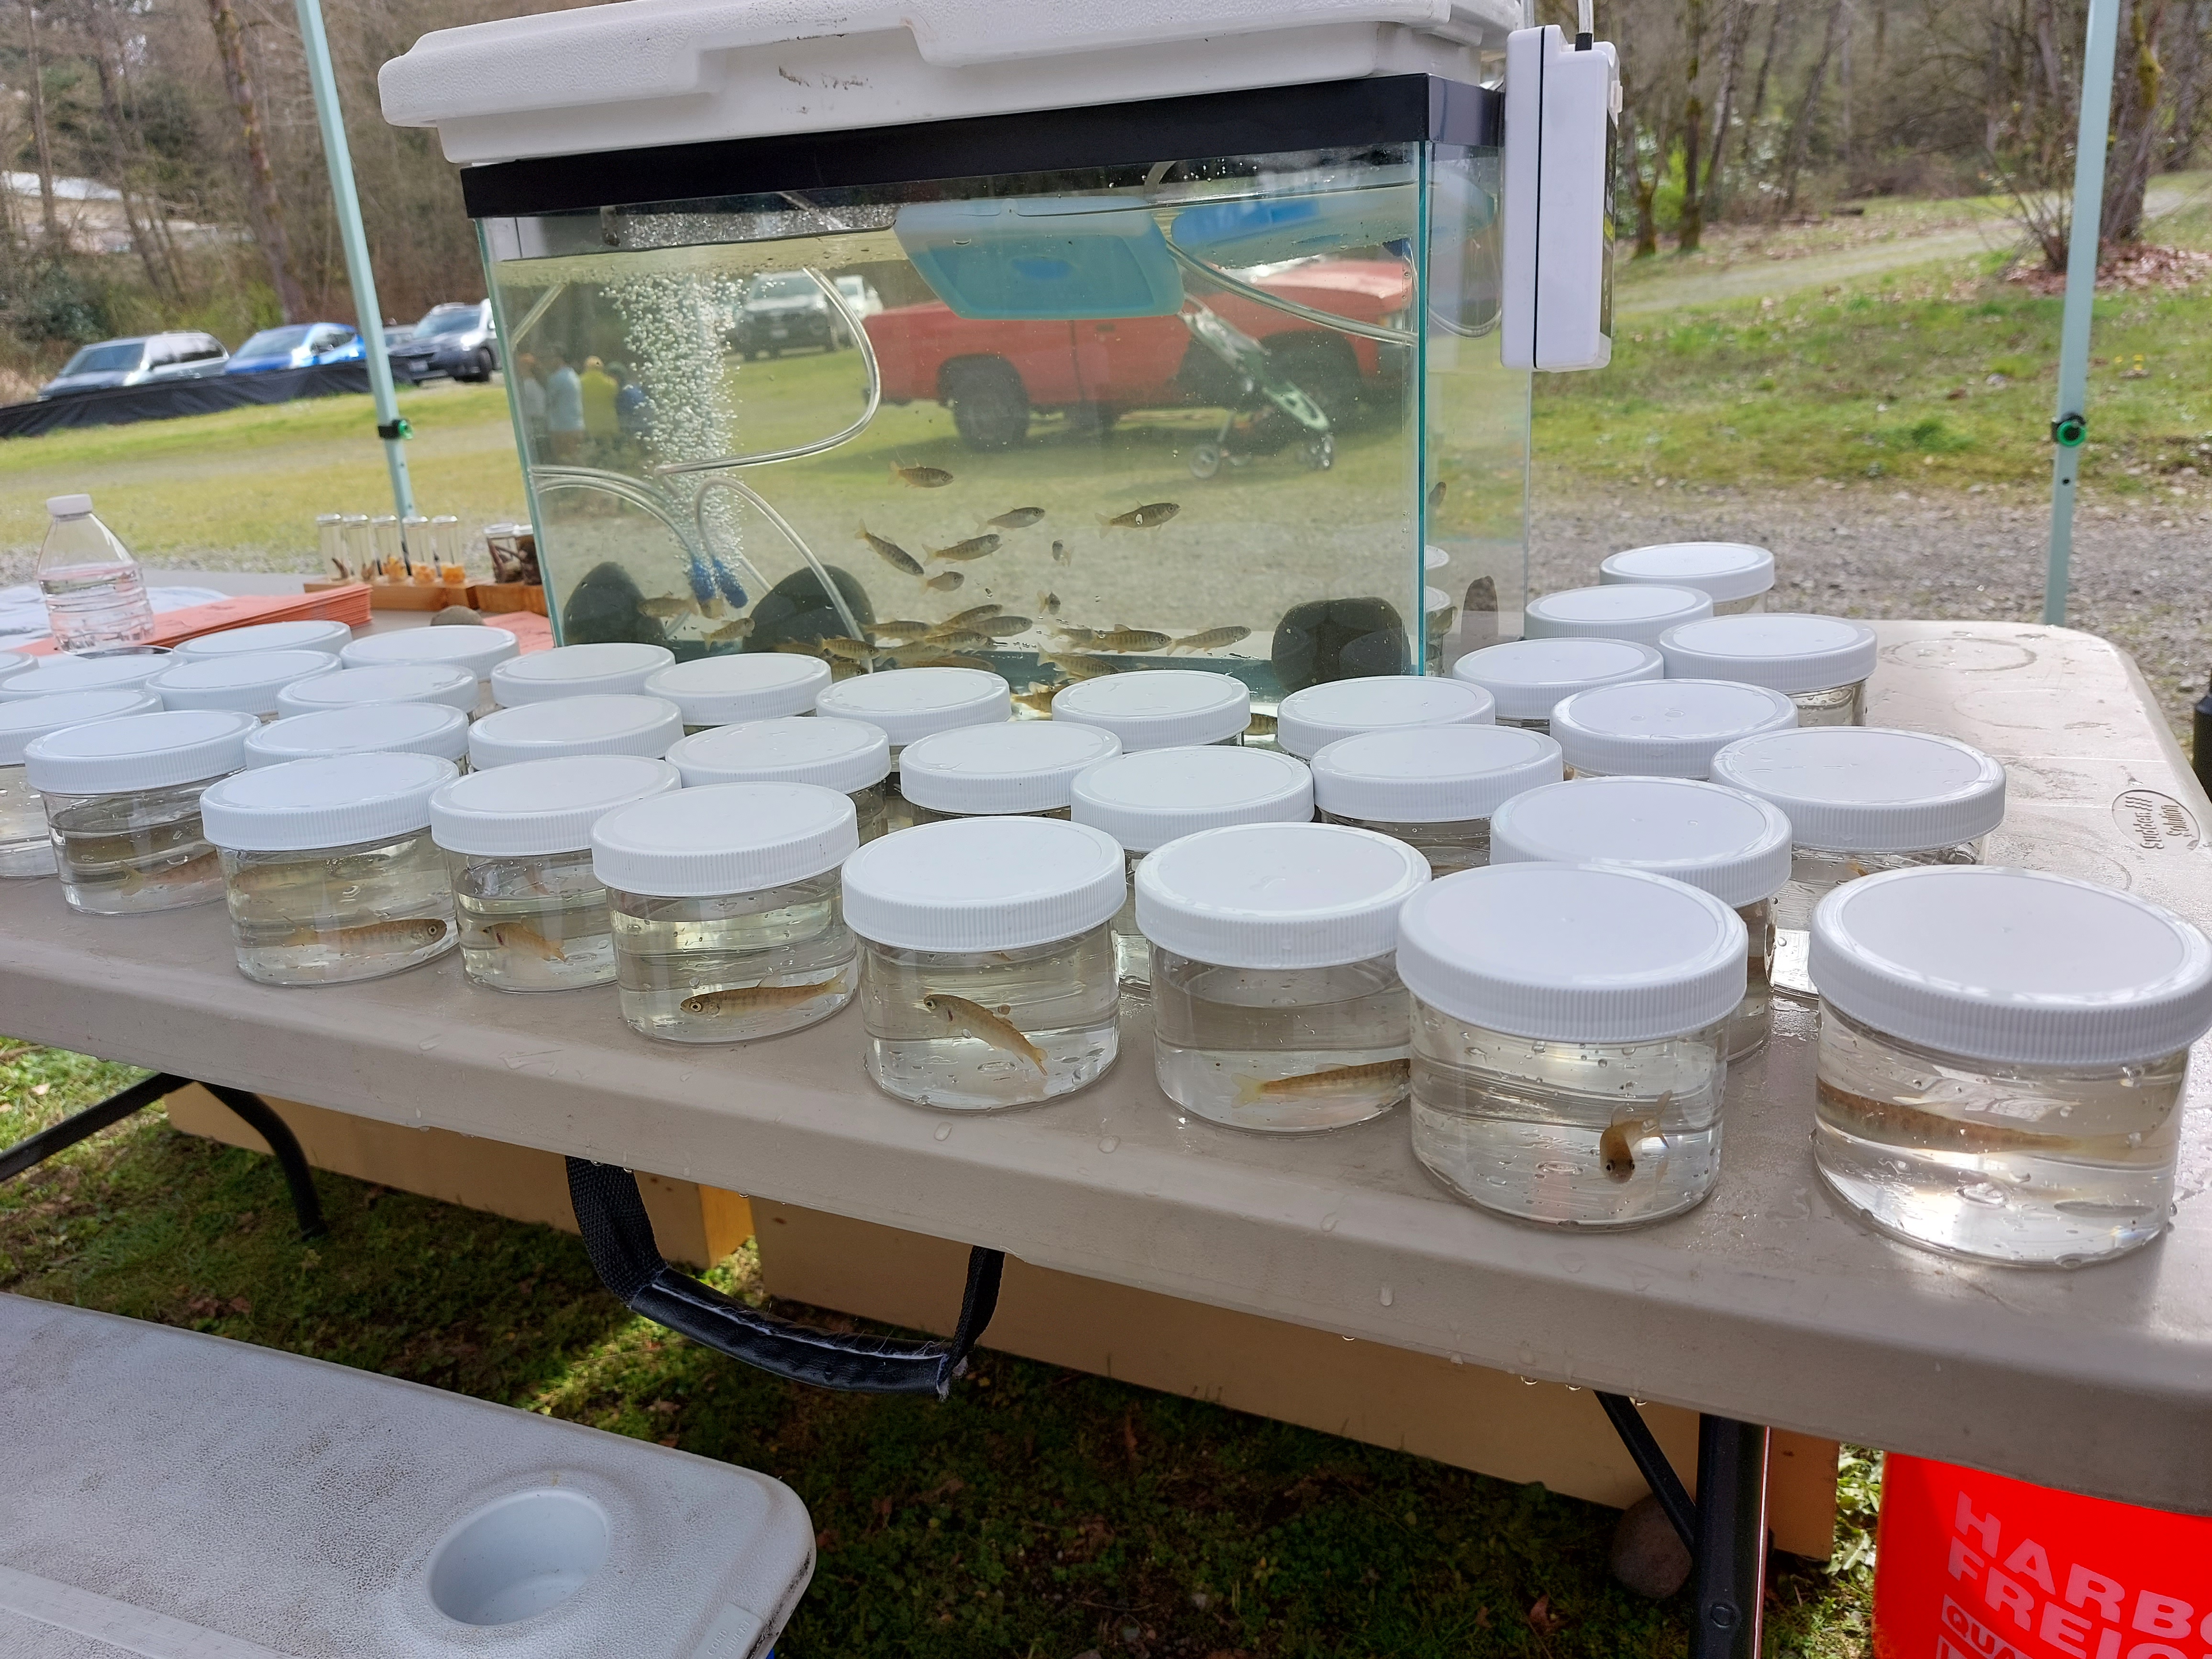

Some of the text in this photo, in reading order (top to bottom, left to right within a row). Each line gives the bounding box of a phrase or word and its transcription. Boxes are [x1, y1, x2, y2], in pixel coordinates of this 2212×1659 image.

[2133, 812, 2165, 850] Sudden
[1948, 1536, 2212, 1659] FREI
[1954, 1491, 2212, 1646] HARB
[707, 1629, 728, 1656] CORD
